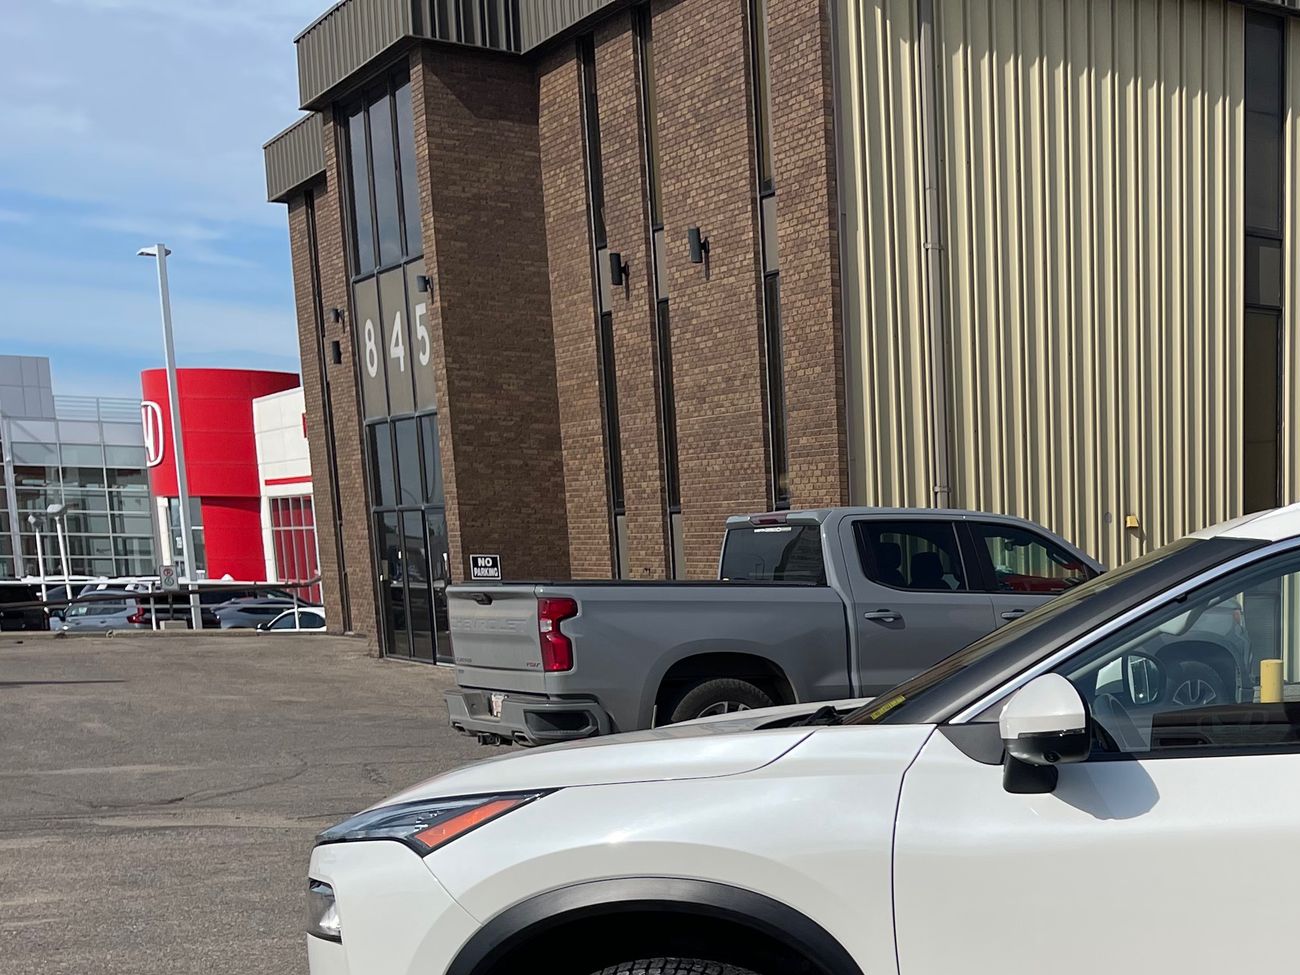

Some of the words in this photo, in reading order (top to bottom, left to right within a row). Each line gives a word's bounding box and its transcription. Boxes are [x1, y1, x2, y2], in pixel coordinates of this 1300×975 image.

[364, 303, 430, 378] 845
[477, 557, 493, 567] NO
[473, 567, 499, 577] PARKING
